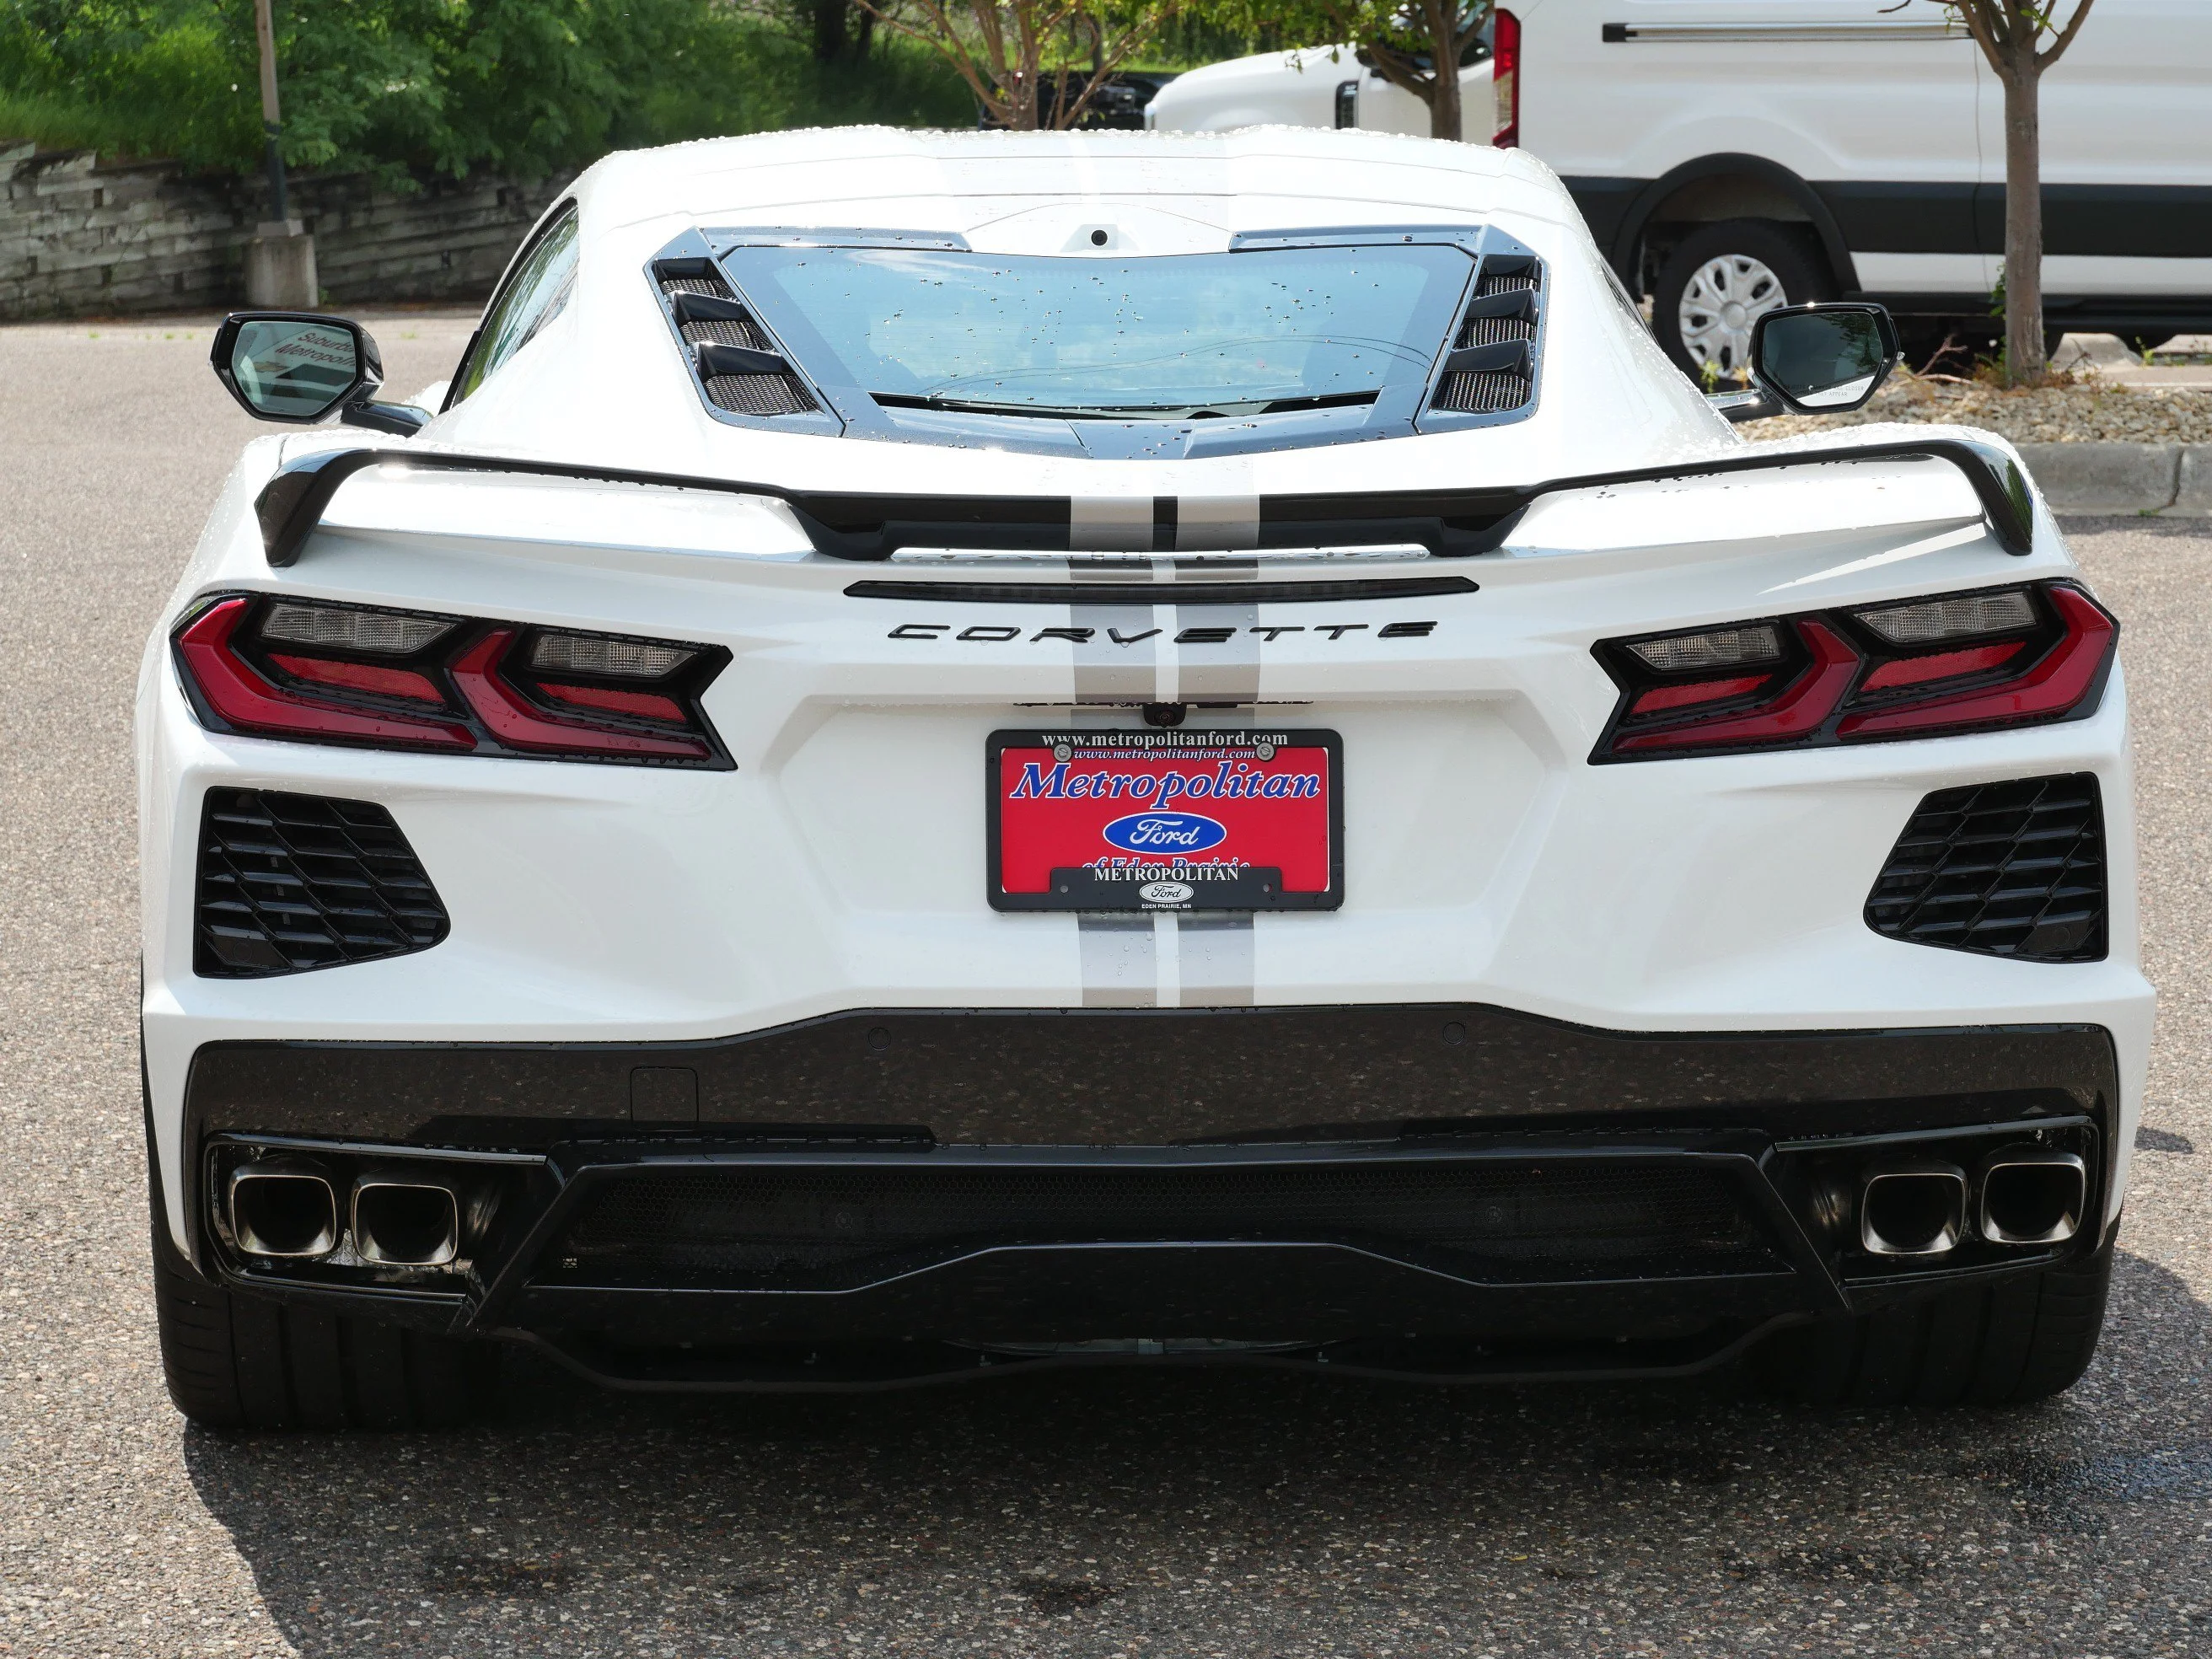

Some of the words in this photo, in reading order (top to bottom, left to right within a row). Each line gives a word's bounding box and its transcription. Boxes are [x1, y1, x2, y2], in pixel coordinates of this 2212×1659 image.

[888, 620, 1438, 643] CORVETTE
[1041, 730, 1288, 749] www.metropolitanford.com
[1074, 748, 1256, 762] www.metropolitanford.com
[1009, 760, 1322, 810] Metropolitan
[1130, 818, 1200, 846] Ford
[1094, 867, 1239, 882] METROPOLITAN
[1151, 884, 1183, 899] Ford
